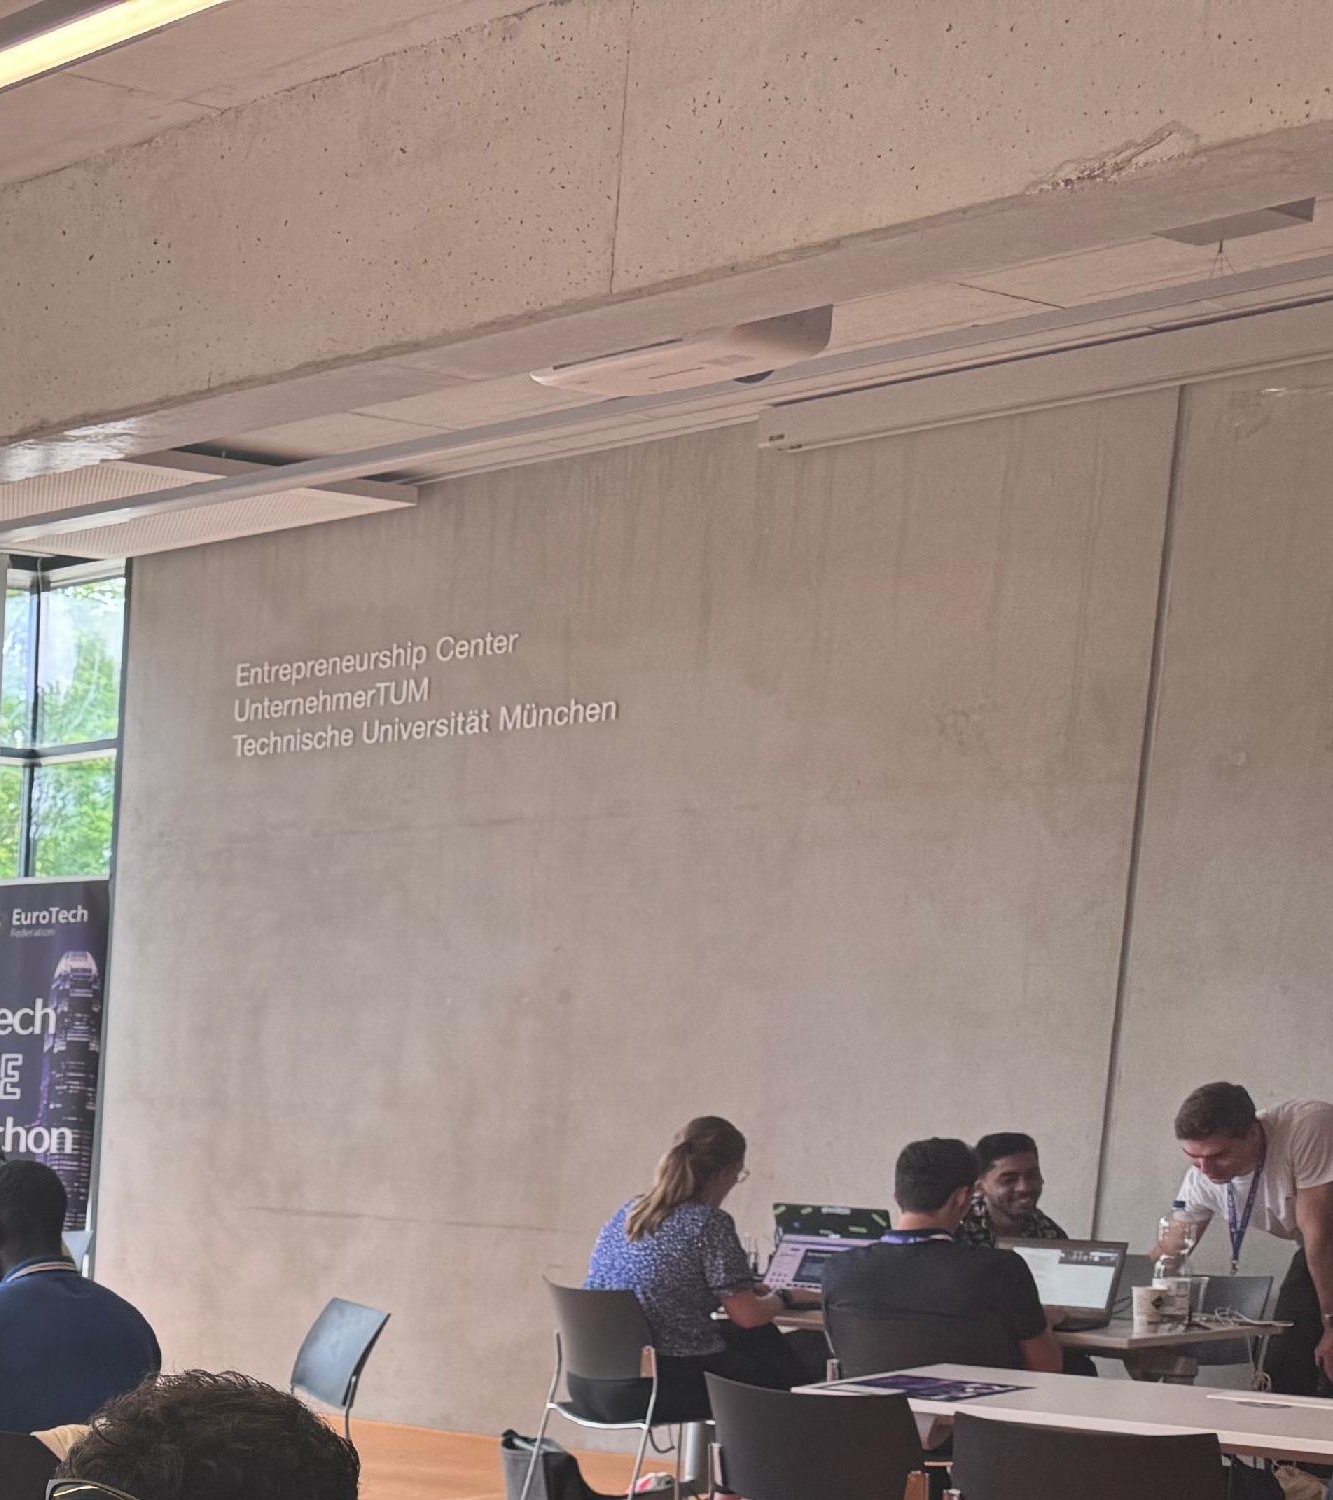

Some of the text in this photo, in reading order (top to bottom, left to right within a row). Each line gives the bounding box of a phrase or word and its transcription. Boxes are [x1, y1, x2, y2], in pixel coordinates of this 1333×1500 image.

[236, 631, 520, 687] Entrepreneurship Center
[234, 677, 430, 723] UnternehmerTUM
[232, 699, 618, 758] Technische Universität München
[12, 905, 88, 926] EuroTech
